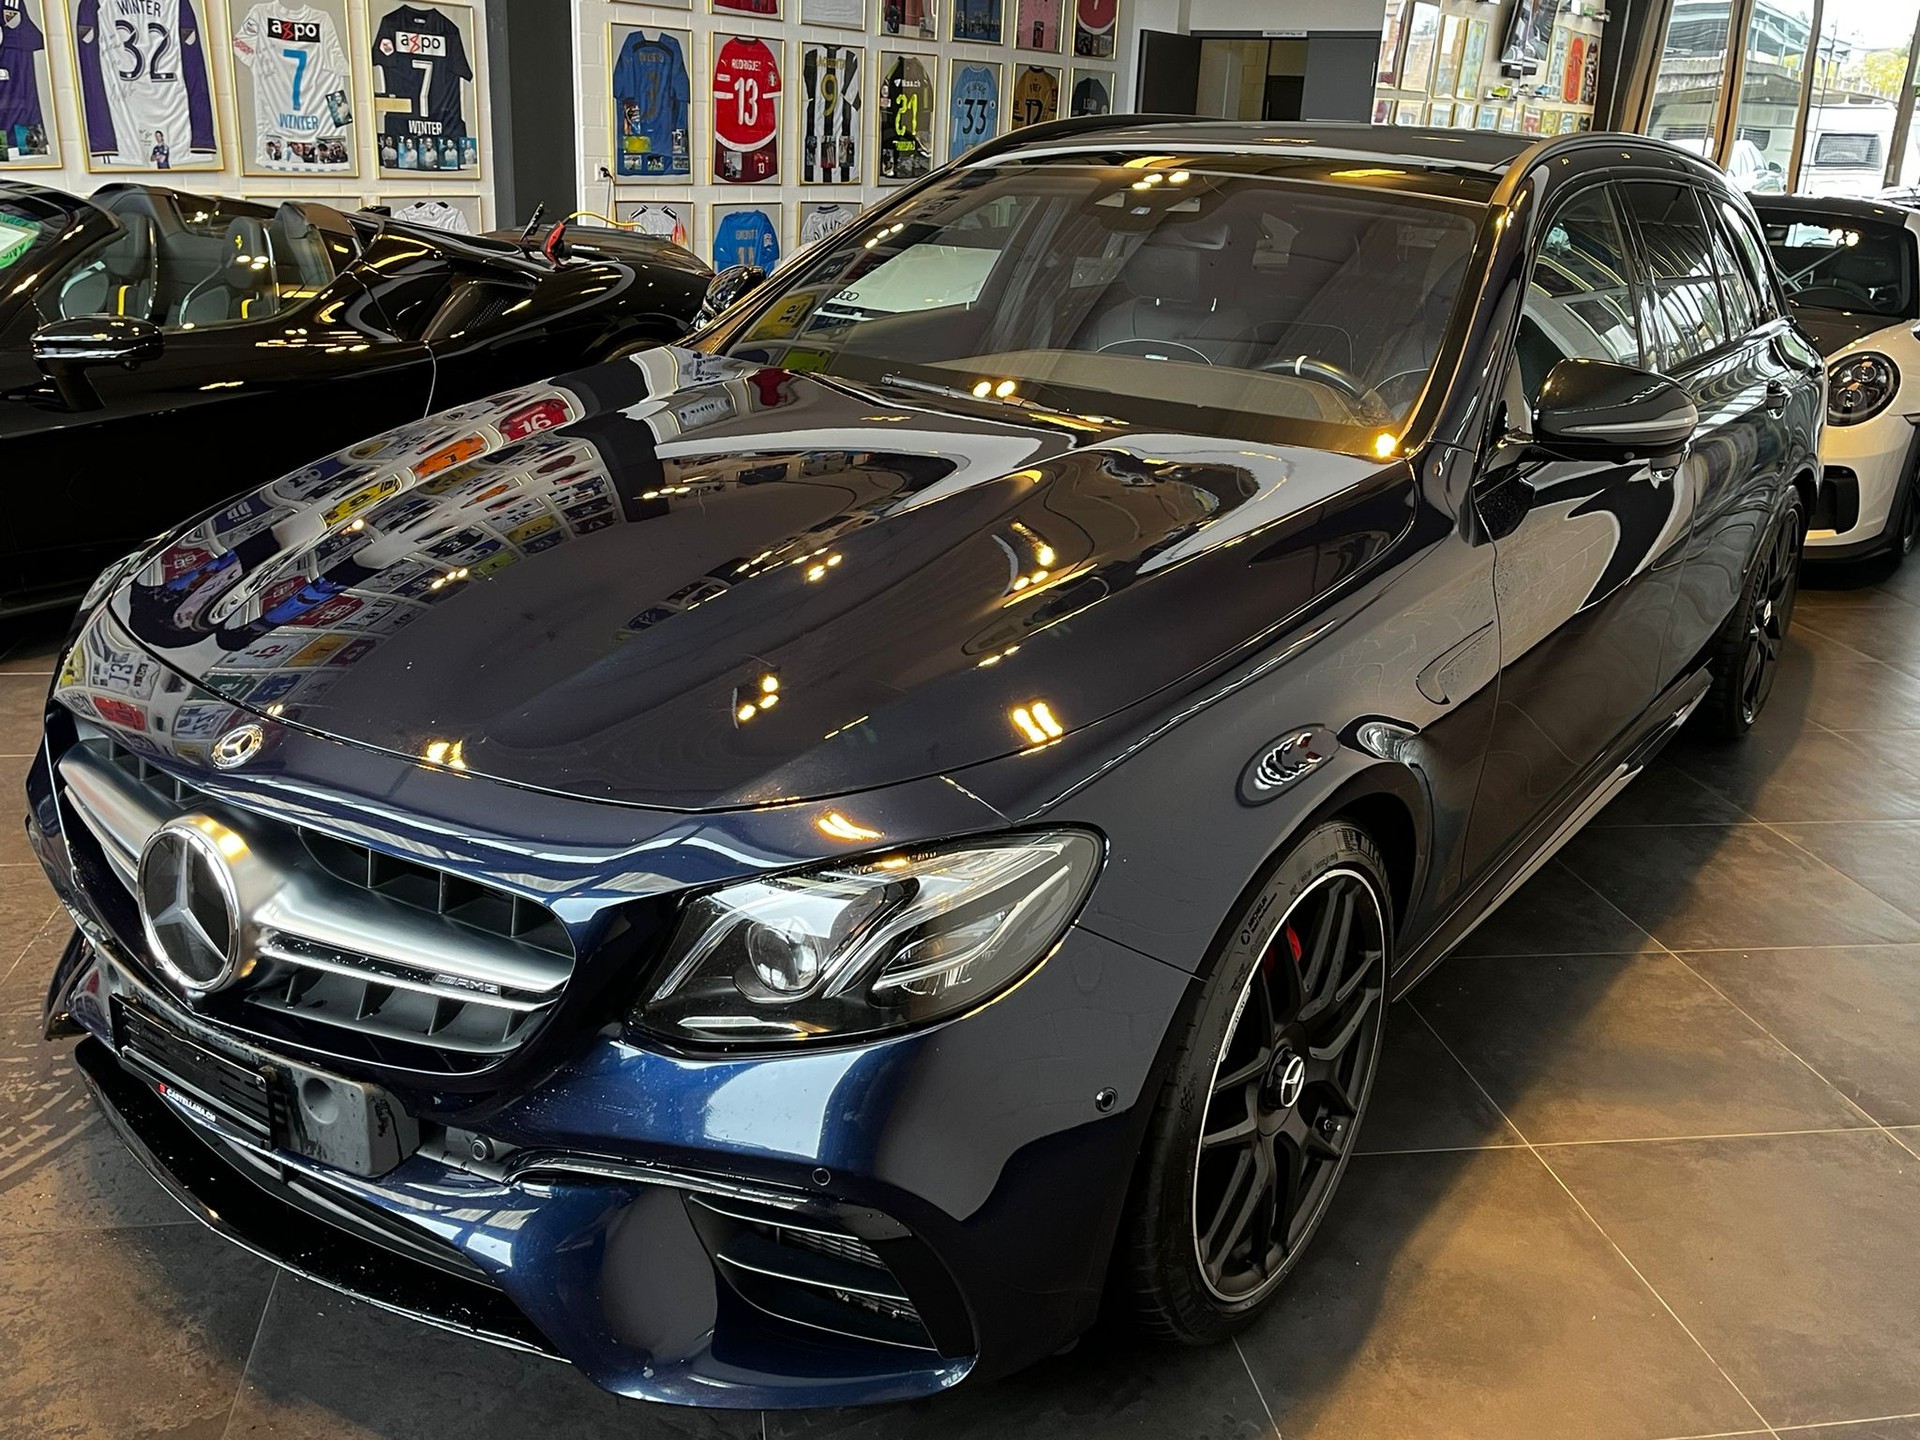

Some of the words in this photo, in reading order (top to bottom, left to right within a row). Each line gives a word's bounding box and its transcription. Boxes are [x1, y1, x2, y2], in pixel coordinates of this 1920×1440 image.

[117, 0, 161, 17] WINTER
[115, 19, 178, 83] 32
[283, 48, 307, 111] 7
[411, 59, 433, 118] 7
[820, 73, 838, 117] 9
[279, 112, 319, 131] WINTER
[733, 76, 759, 126] 13
[962, 97, 988, 136] 33
[408, 119, 443, 136] WINTER
[455, 977, 499, 994] AMG
